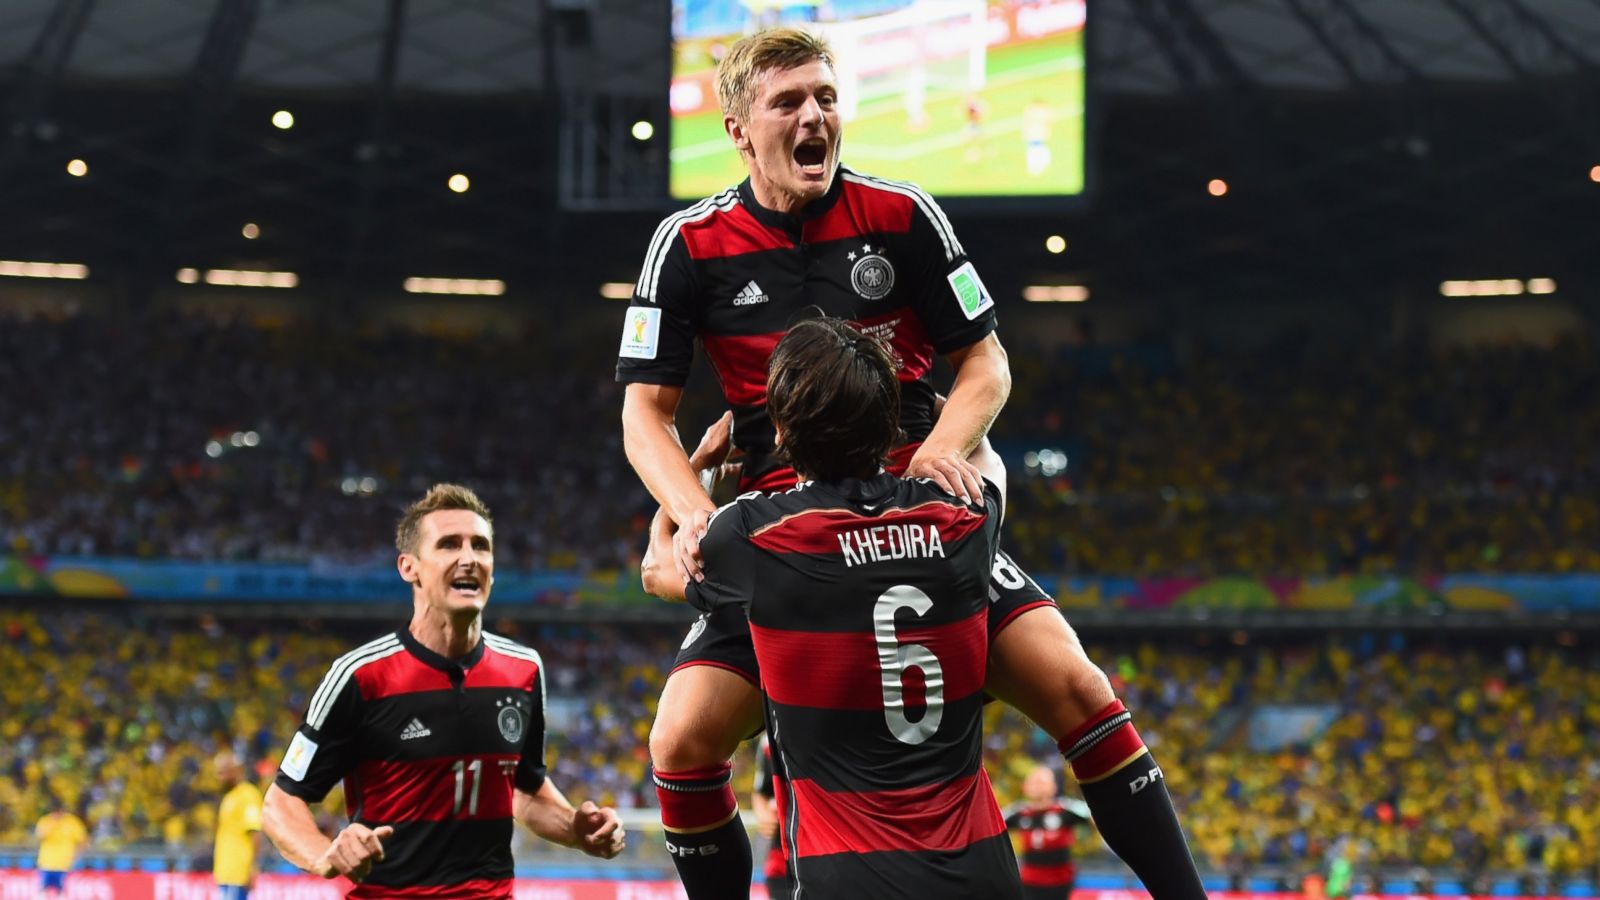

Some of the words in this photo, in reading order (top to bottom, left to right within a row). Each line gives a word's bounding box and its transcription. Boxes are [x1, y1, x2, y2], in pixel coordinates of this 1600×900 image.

[733, 294, 769, 306] adidas
[837, 524, 945, 567] KHEDIRA
[873, 584, 944, 745] 6
[452, 760, 482, 816] 11
[665, 840, 719, 857] DFB
